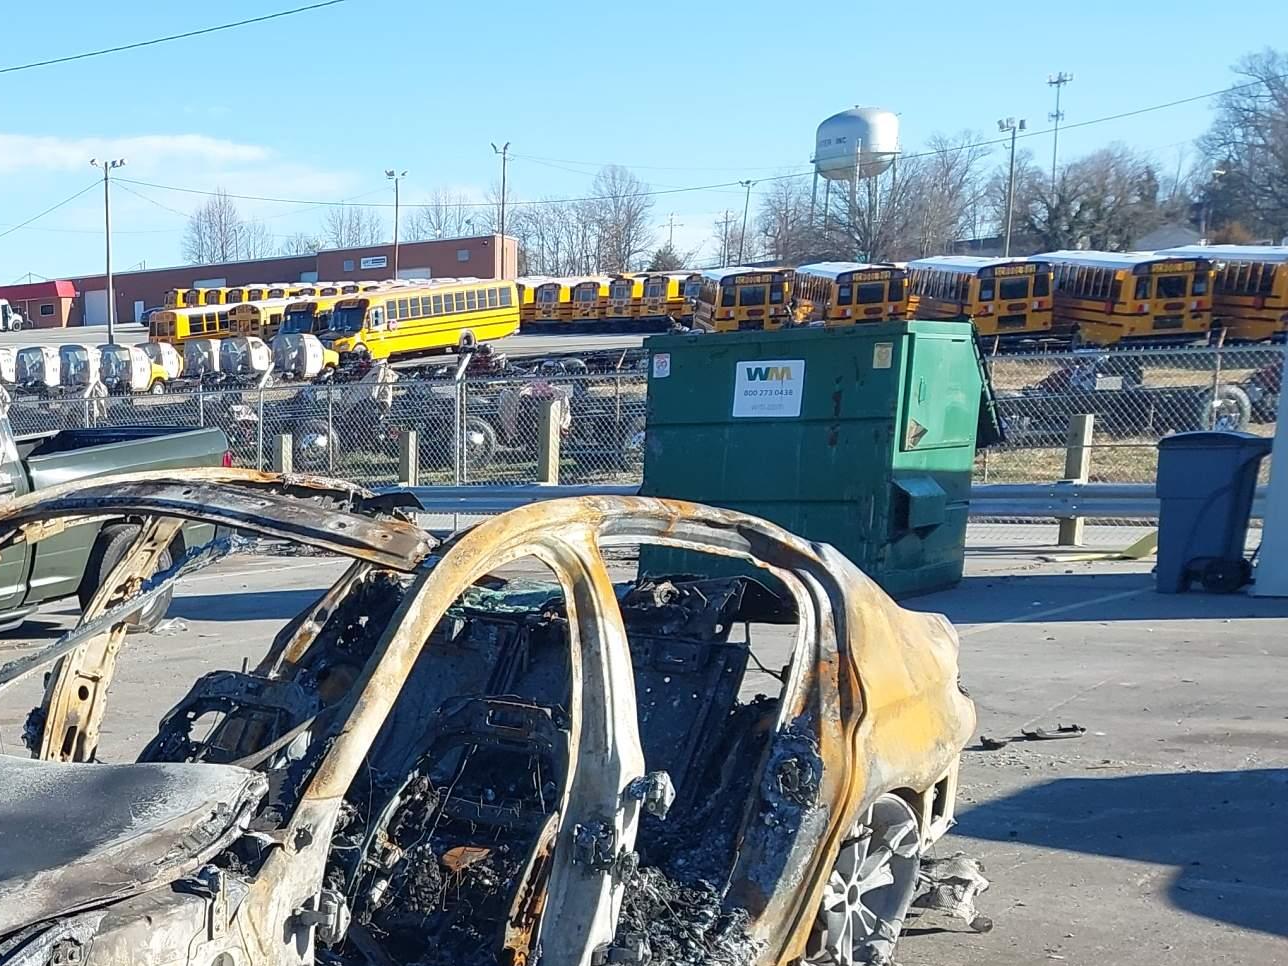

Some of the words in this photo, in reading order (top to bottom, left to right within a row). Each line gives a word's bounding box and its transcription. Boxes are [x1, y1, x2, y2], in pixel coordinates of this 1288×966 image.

[746, 366, 793, 382] WM
[743, 389, 758, 397] 800
[759, 389, 773, 397] 273
[774, 389, 793, 397] 0438
